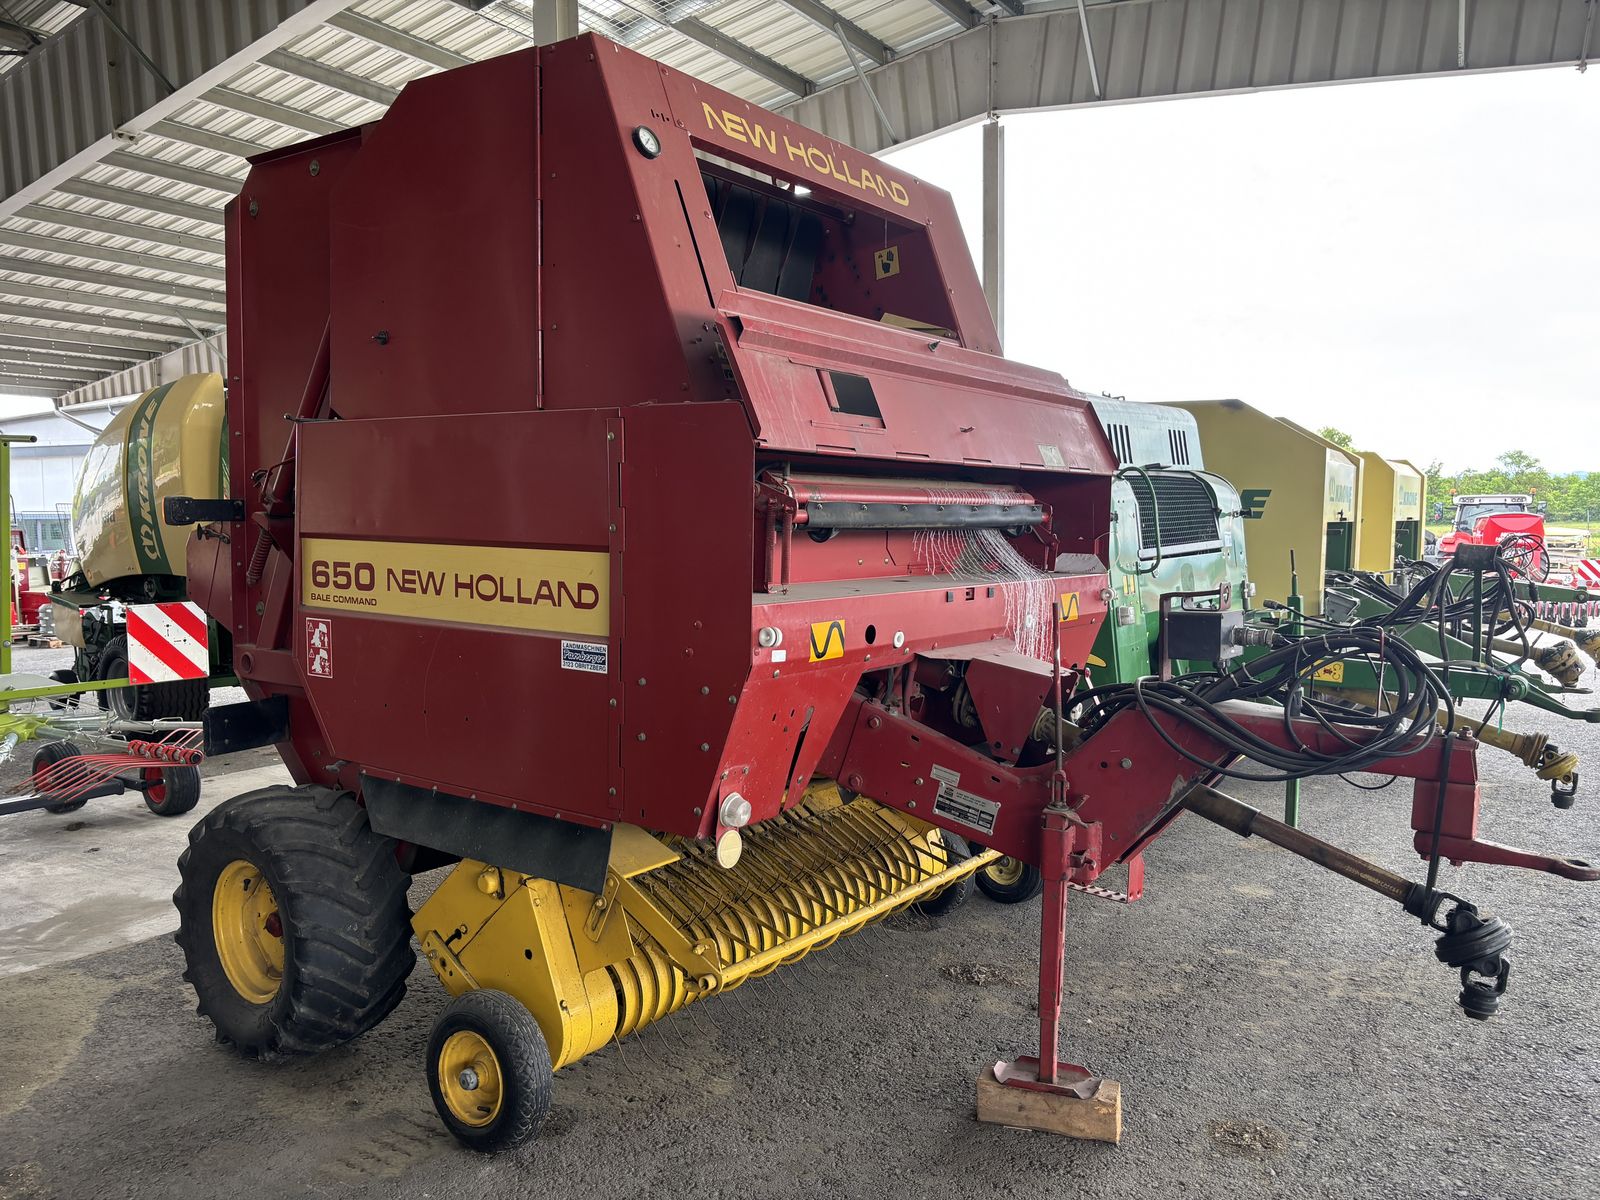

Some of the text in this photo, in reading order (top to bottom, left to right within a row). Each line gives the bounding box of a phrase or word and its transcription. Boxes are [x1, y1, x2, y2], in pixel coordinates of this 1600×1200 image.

[702, 101, 909, 206] NEW HOLLAND
[138, 398, 158, 523] KRONE
[311, 560, 600, 610] 650 NEW HOLLAND
[311, 593, 377, 606] BALE COMMAND
[563, 642, 606, 651] LANDMASCHINEN
[574, 662, 606, 672] OBRITZBERG
